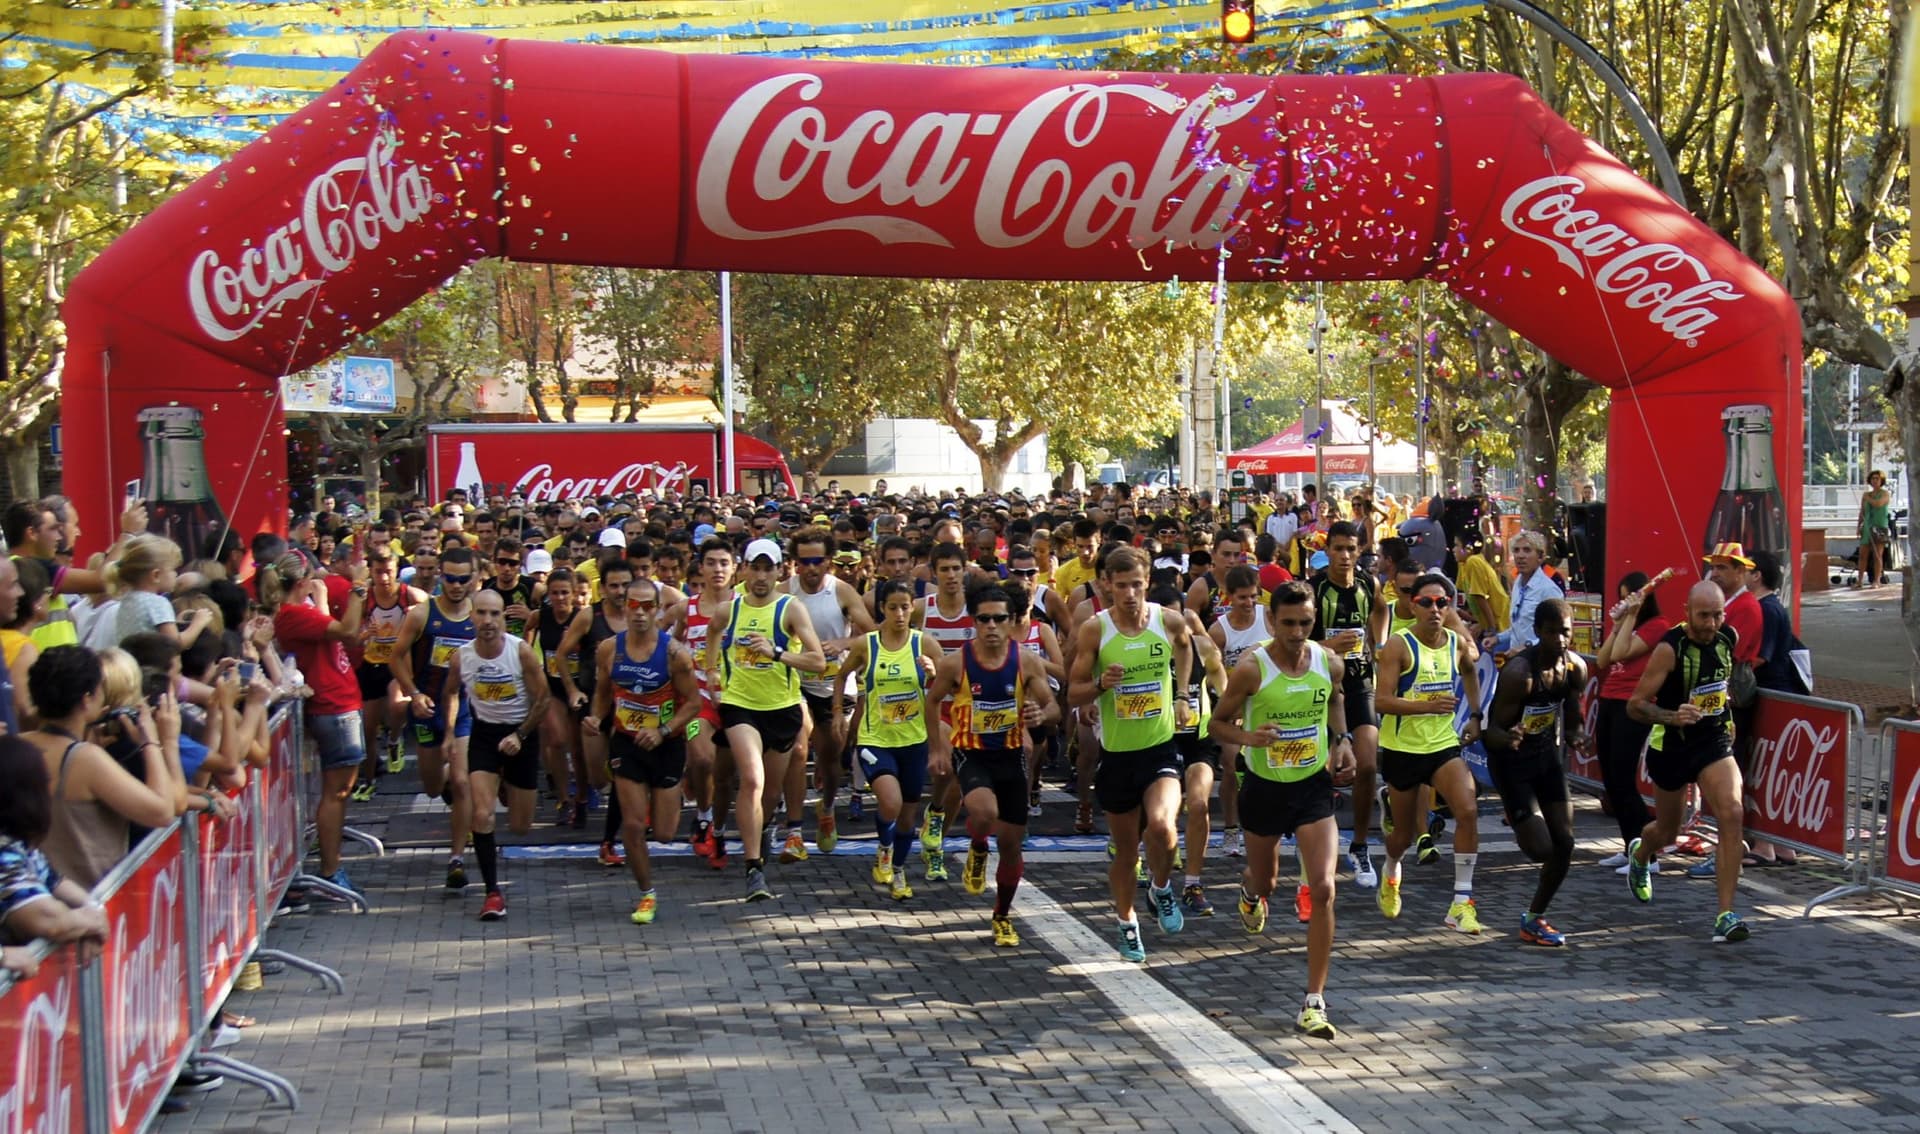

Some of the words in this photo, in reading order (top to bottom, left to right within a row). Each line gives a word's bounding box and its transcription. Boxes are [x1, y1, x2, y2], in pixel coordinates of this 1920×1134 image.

[697, 73, 1267, 250] Coca-Cola
[188, 133, 434, 342] Coca-Cola
[1500, 175, 1745, 341] Coca-Cola
[1151, 642, 1163, 656] LS
[618, 664, 651, 675] saucony
[888, 664, 901, 675] LS
[1123, 662, 1164, 675] SANSI.COM
[1715, 668, 1724, 679] LS
[1313, 689, 1326, 704] LS
[1267, 709, 1323, 719] LASANSI.COM
